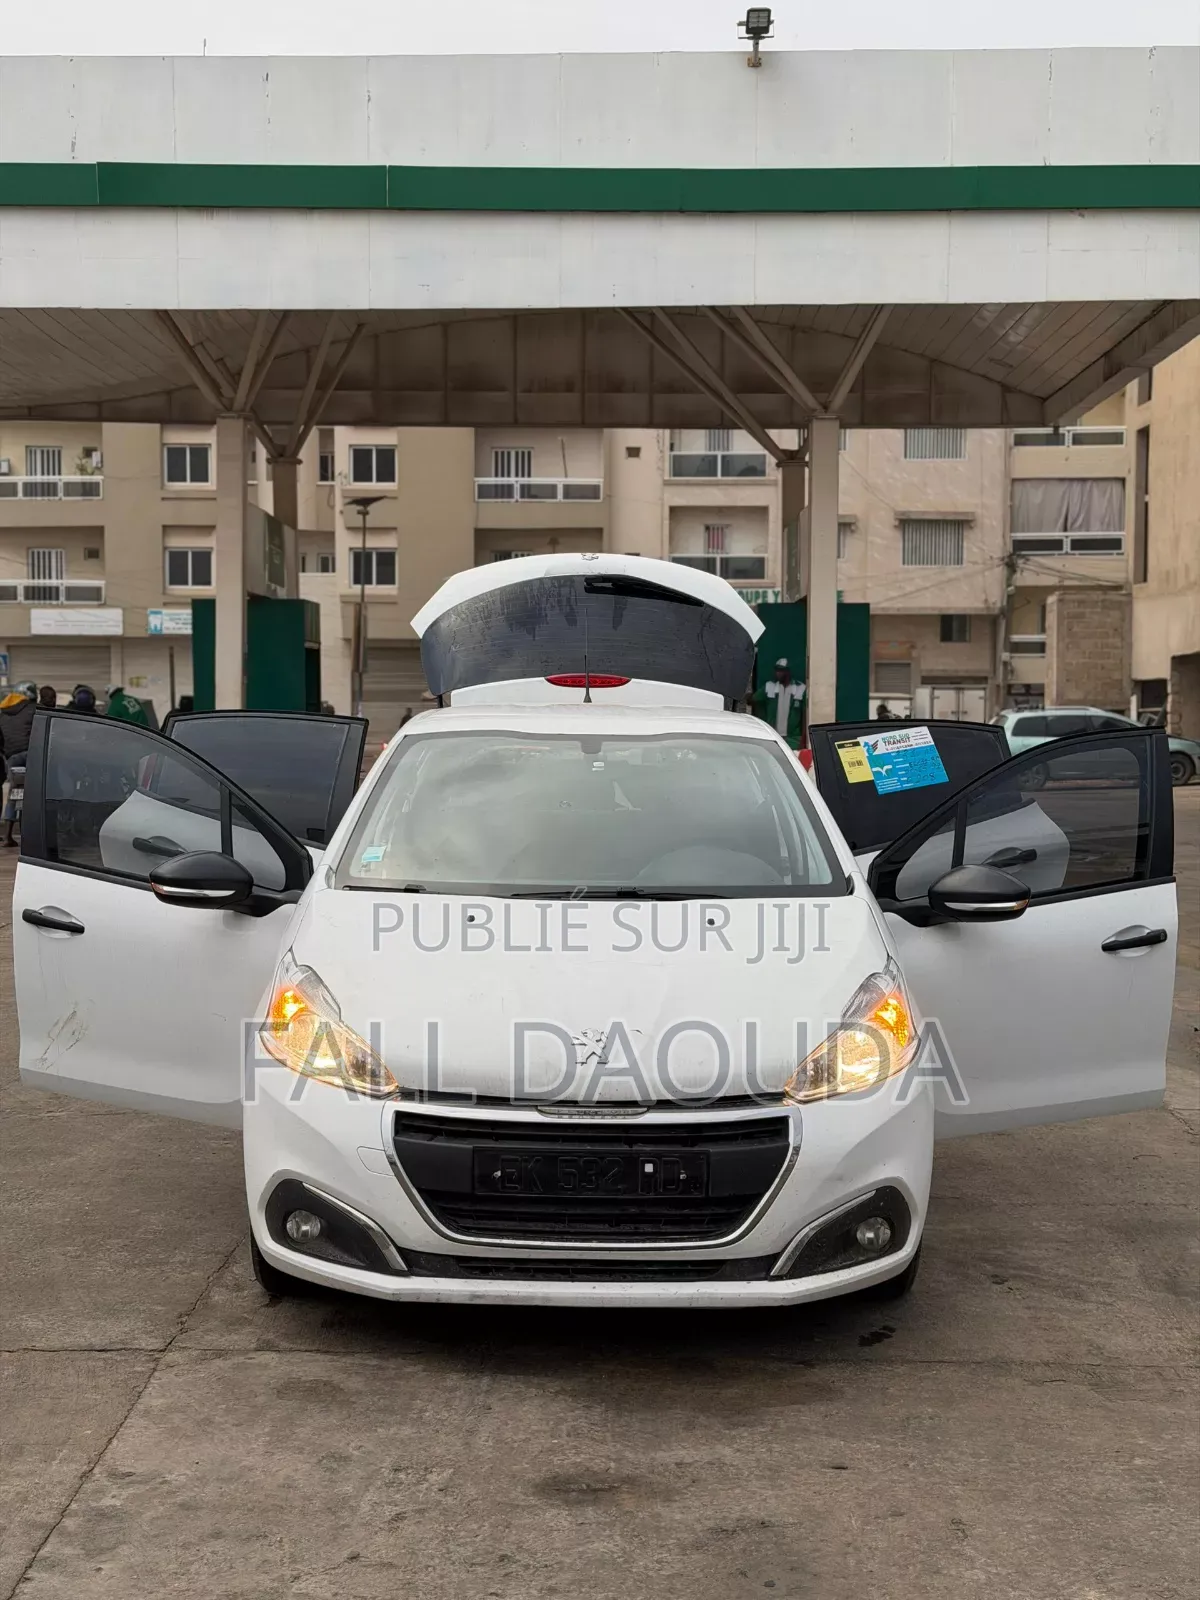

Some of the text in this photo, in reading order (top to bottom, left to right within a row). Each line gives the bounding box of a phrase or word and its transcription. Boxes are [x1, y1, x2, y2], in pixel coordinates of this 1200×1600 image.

[738, 590, 769, 603] OUPE
[884, 737, 911, 747] TRANSIT
[557, 1156, 626, 1195] 532
